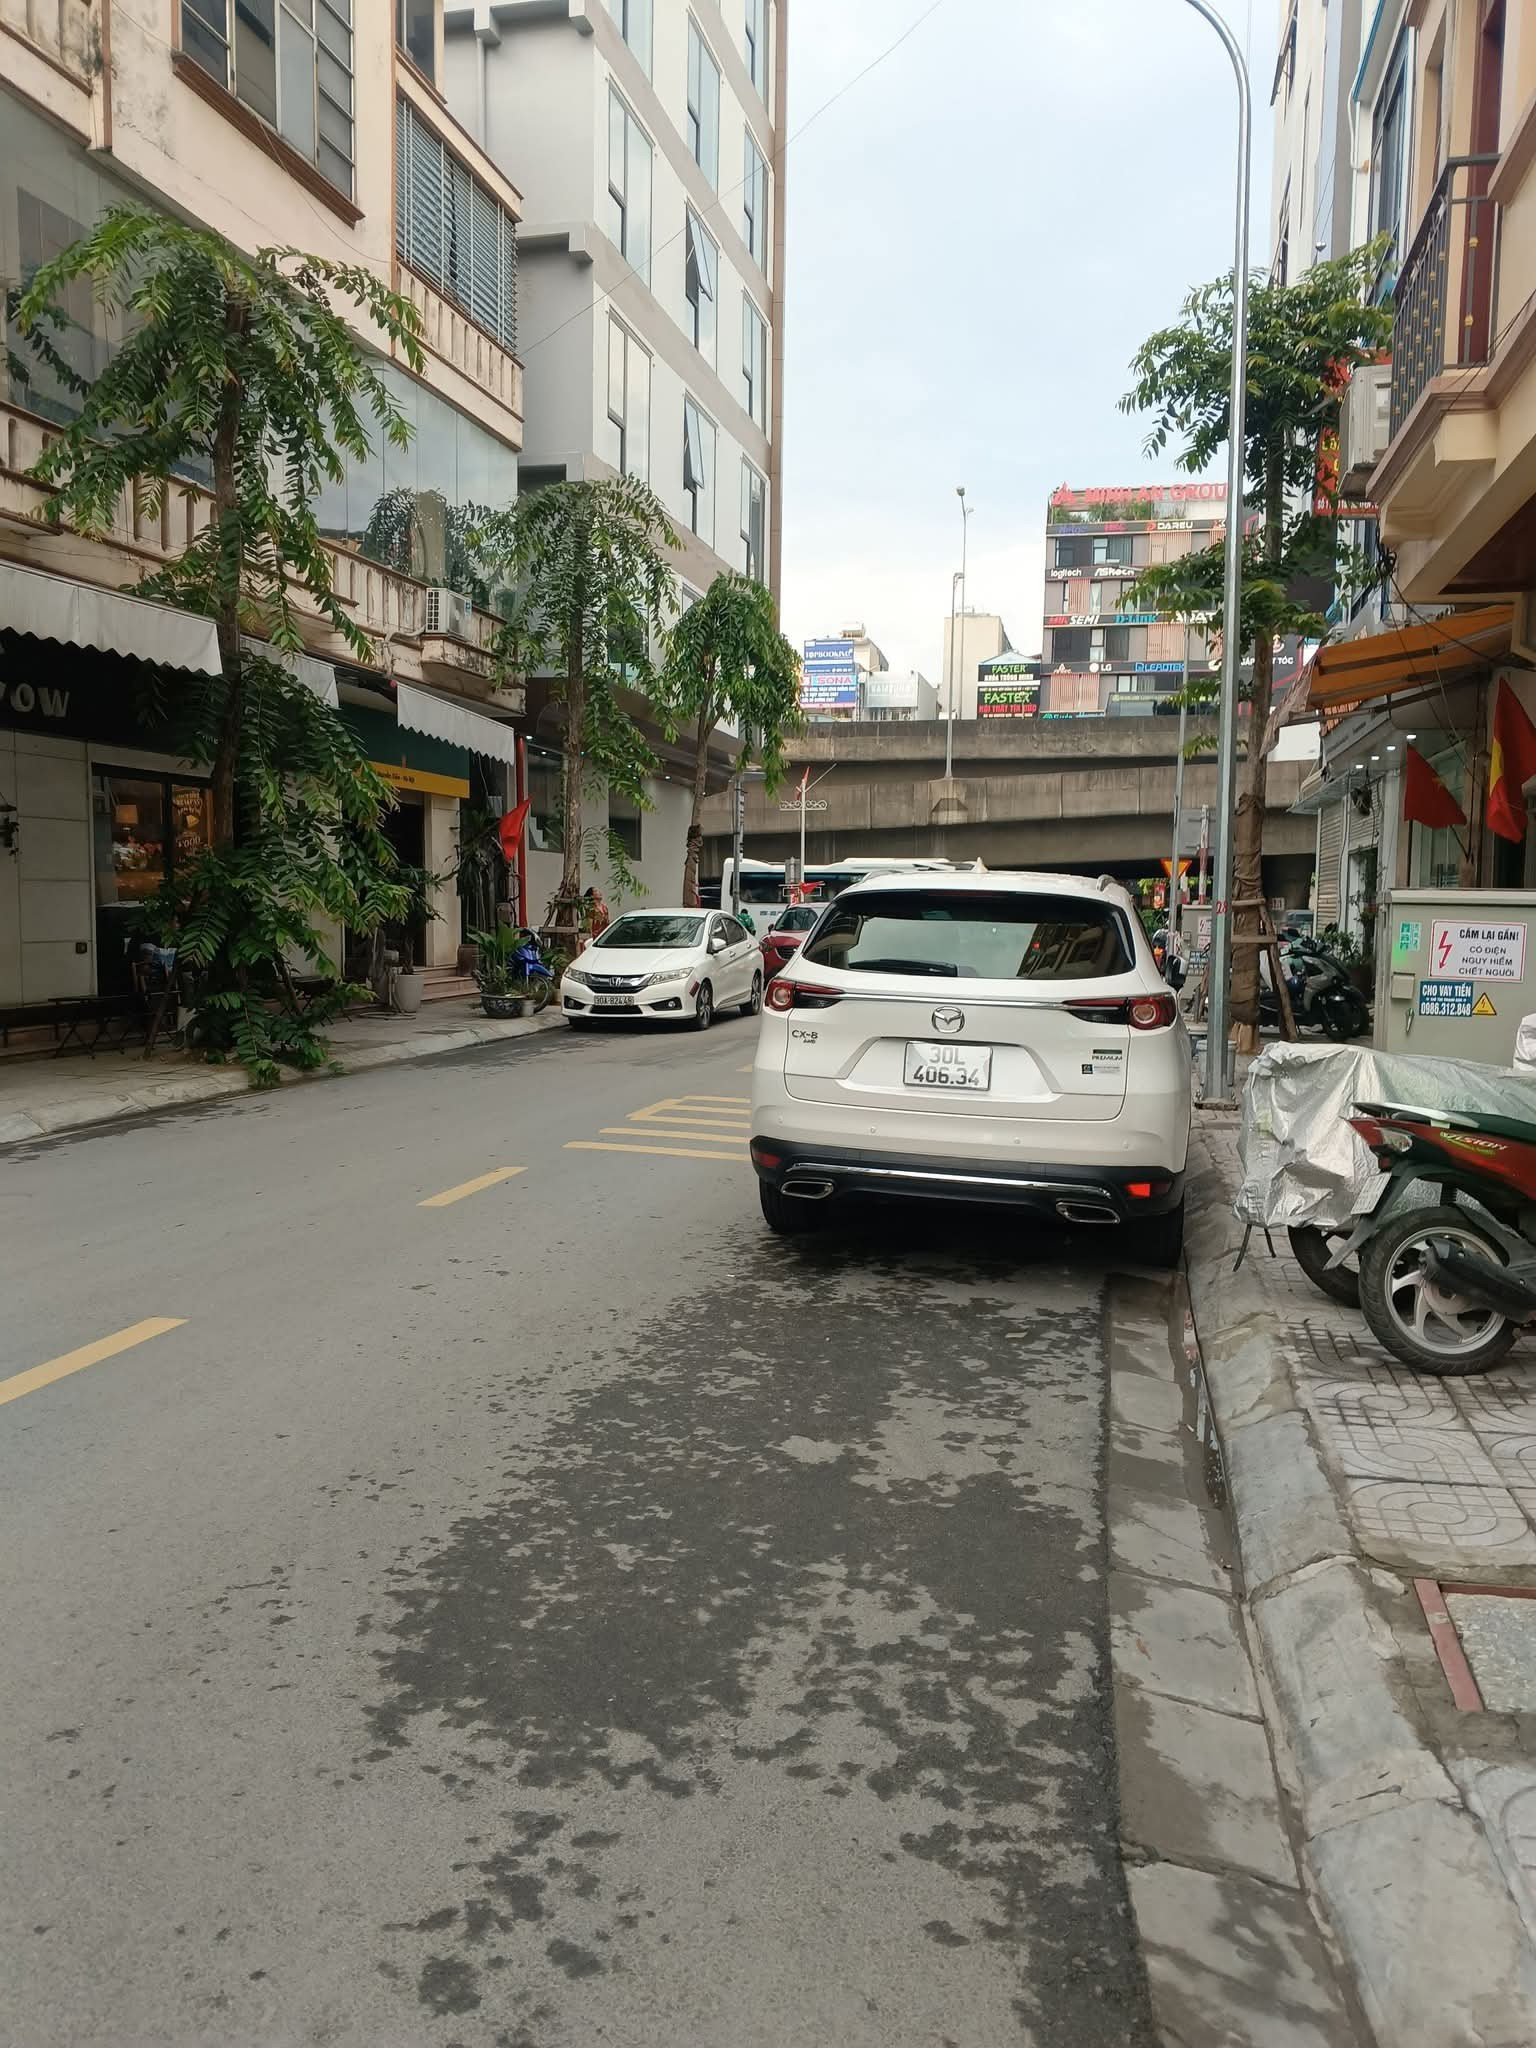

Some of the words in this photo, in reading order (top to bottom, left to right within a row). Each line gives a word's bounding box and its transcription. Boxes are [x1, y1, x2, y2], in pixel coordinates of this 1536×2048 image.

[1139, 486, 1163, 502] AN
[1050, 568, 1082, 579] logitech
[991, 664, 1026, 674] FASTER
[1101, 663, 1112, 672] LG
[817, 676, 853, 685] SONA
[984, 691, 1031, 704] FASTER
[1459, 928, 1479, 940] CẤM
[1482, 930, 1496, 942] LẠI
[1469, 945, 1483, 954] CÓ
[1485, 946, 1507, 956] ĐIỆN
[1462, 956, 1487, 965] NGUY
[1489, 956, 1513, 966] HIỂM
[1458, 967, 1483, 976] CHẾT
[1485, 968, 1515, 977] NGƯỜI
[1422, 985, 1438, 996] CHO
[1439, 985, 1453, 997] VAY
[1455, 982, 1472, 997] TIỀN
[791, 1029, 818, 1039] CX-8
[929, 1045, 966, 1065] 30L
[913, 1065, 980, 1086] 406.34
